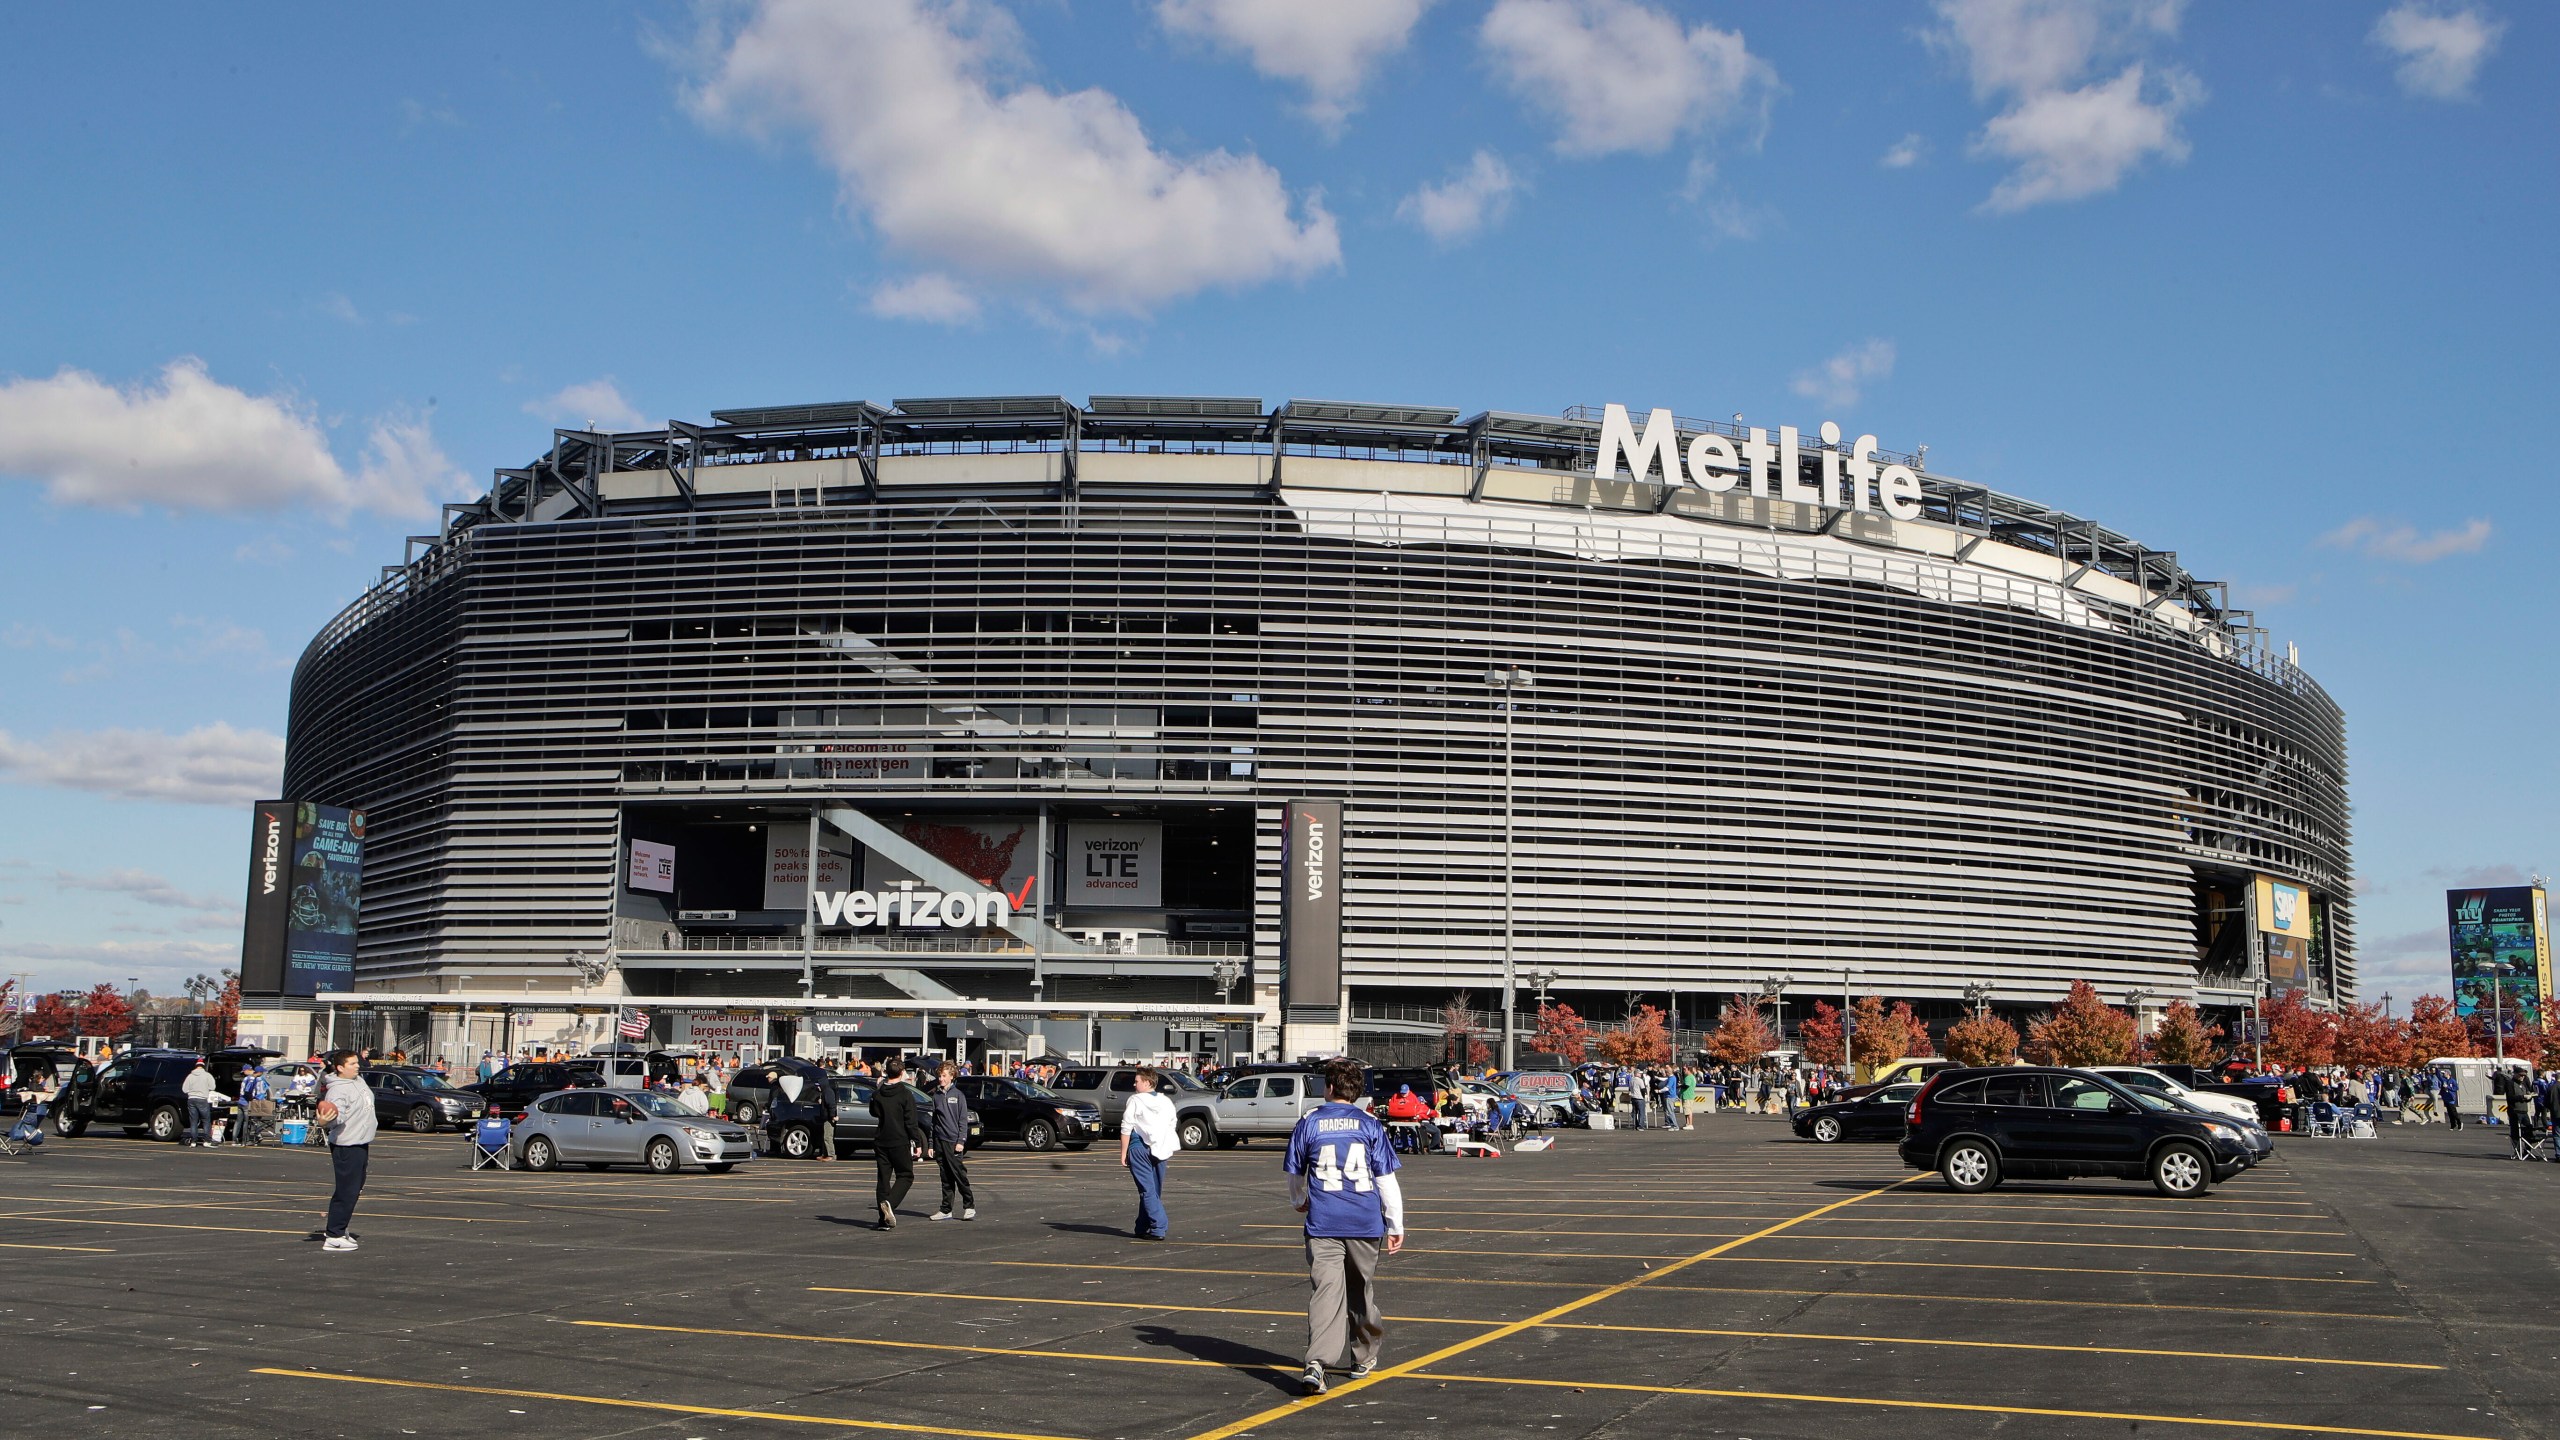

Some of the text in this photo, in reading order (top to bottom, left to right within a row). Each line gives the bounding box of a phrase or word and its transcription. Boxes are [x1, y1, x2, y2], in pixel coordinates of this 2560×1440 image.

[1595, 403, 1922, 521] MetLife
[845, 758, 878, 770] next
[881, 759, 909, 772] gen
[318, 819, 348, 832] SAVE BIG
[313, 836, 359, 855] GAME-DAY
[1085, 838, 1138, 851] verizon
[263, 822, 281, 895] verizon
[327, 853, 360, 865] FAVORITES AT
[774, 848, 830, 858] 50% fater
[773, 861, 799, 872] peak
[1086, 854, 1138, 877] LTE
[1304, 823, 1324, 901] verizon
[658, 864, 671, 875] LTE
[1086, 879, 1138, 889] advanced
[814, 880, 1009, 928] verizon
[2275, 891, 2296, 923] SAP
[292, 961, 302, 969] THE
[303, 962, 316, 970] NEW
[331, 964, 352, 972] GIANTS
[321, 982, 333, 990] PNC
[690, 1025, 759, 1038] largest and
[816, 1021, 858, 1032] verizon
[710, 1039, 734, 1051] LTE
[1164, 1027, 1218, 1052] LTE
[1520, 1075, 1567, 1087] GIANTS
[1319, 1117, 1360, 1133] BRADSHAW
[1315, 1143, 1374, 1192] 44
